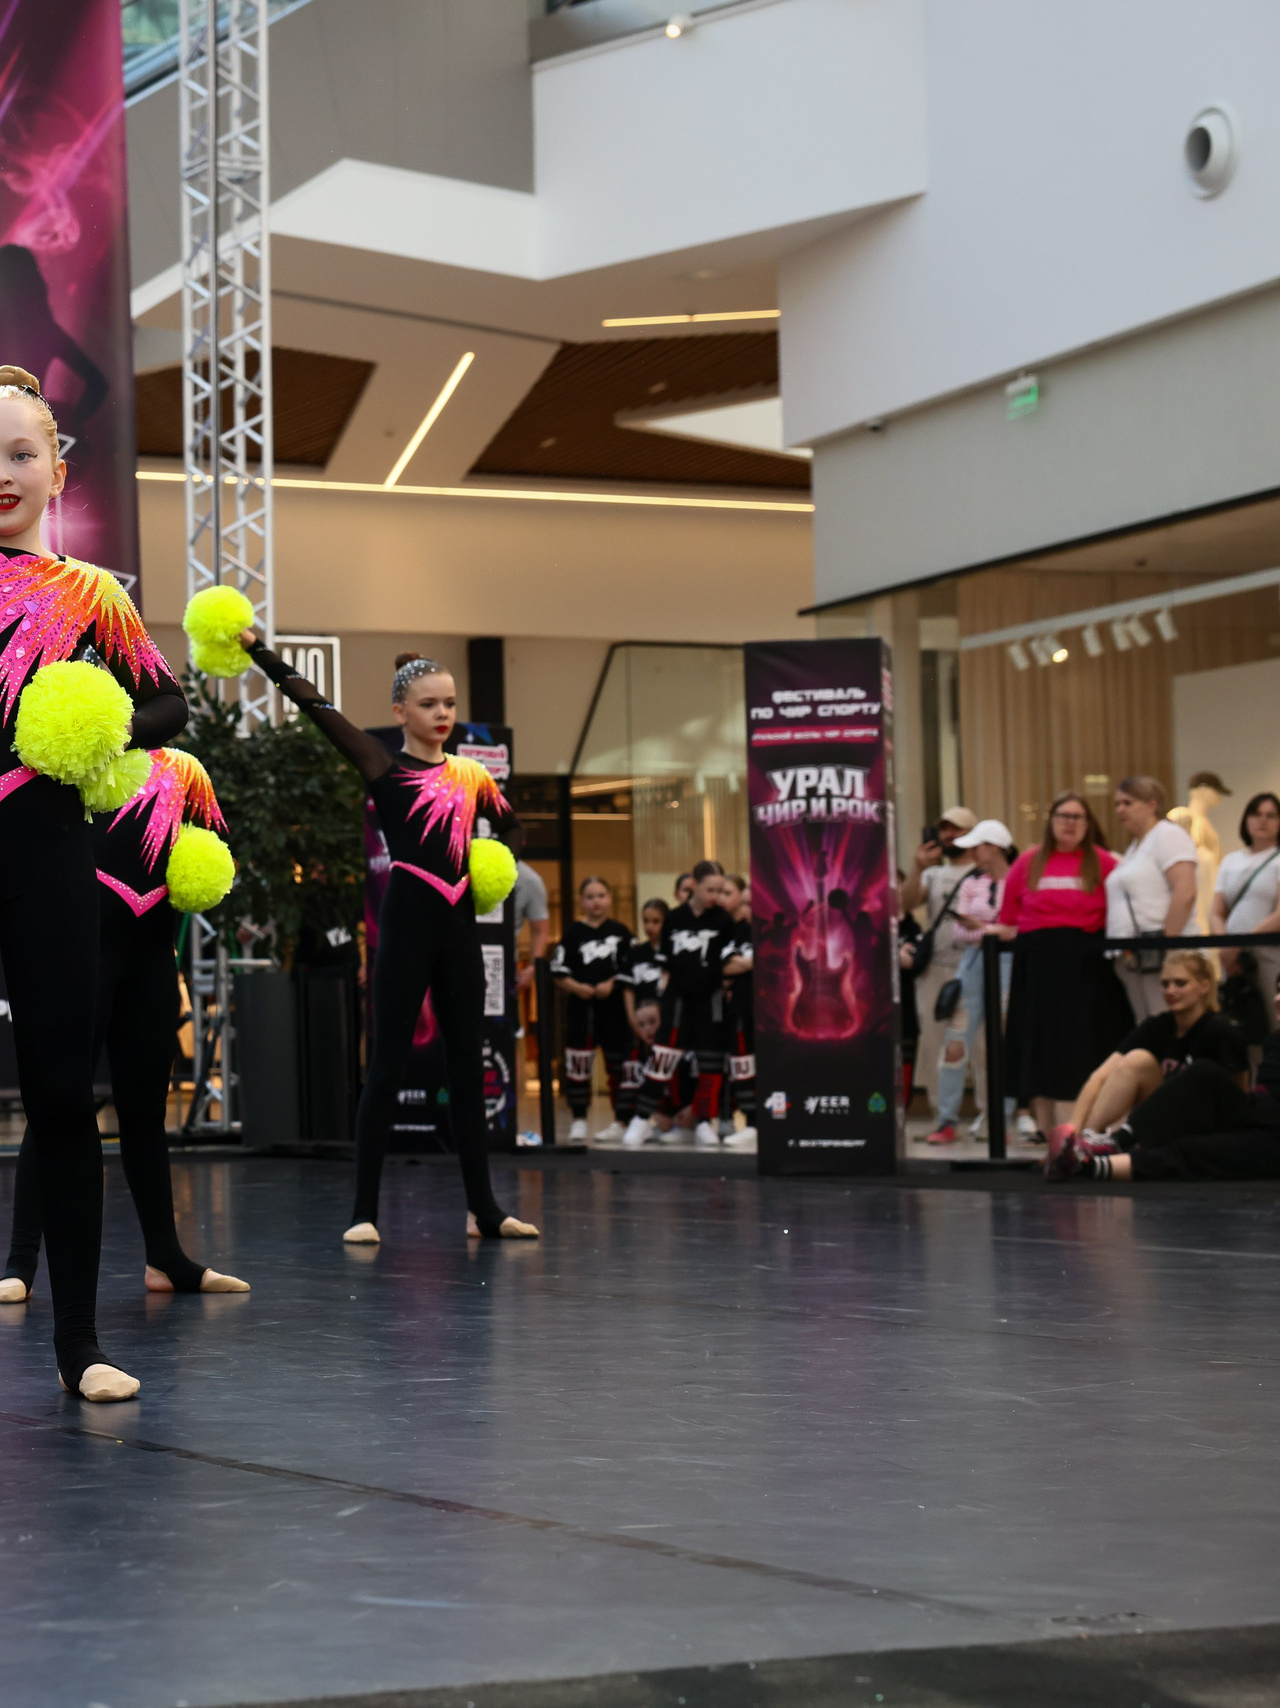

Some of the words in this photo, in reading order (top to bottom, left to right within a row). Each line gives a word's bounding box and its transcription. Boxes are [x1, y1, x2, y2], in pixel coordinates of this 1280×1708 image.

[751, 707, 774, 719] ПО
[772, 766, 865, 801] УРАЛ
[757, 799, 806, 826] ЧИР
[811, 799, 827, 817] И
[832, 799, 880, 822] РОК
